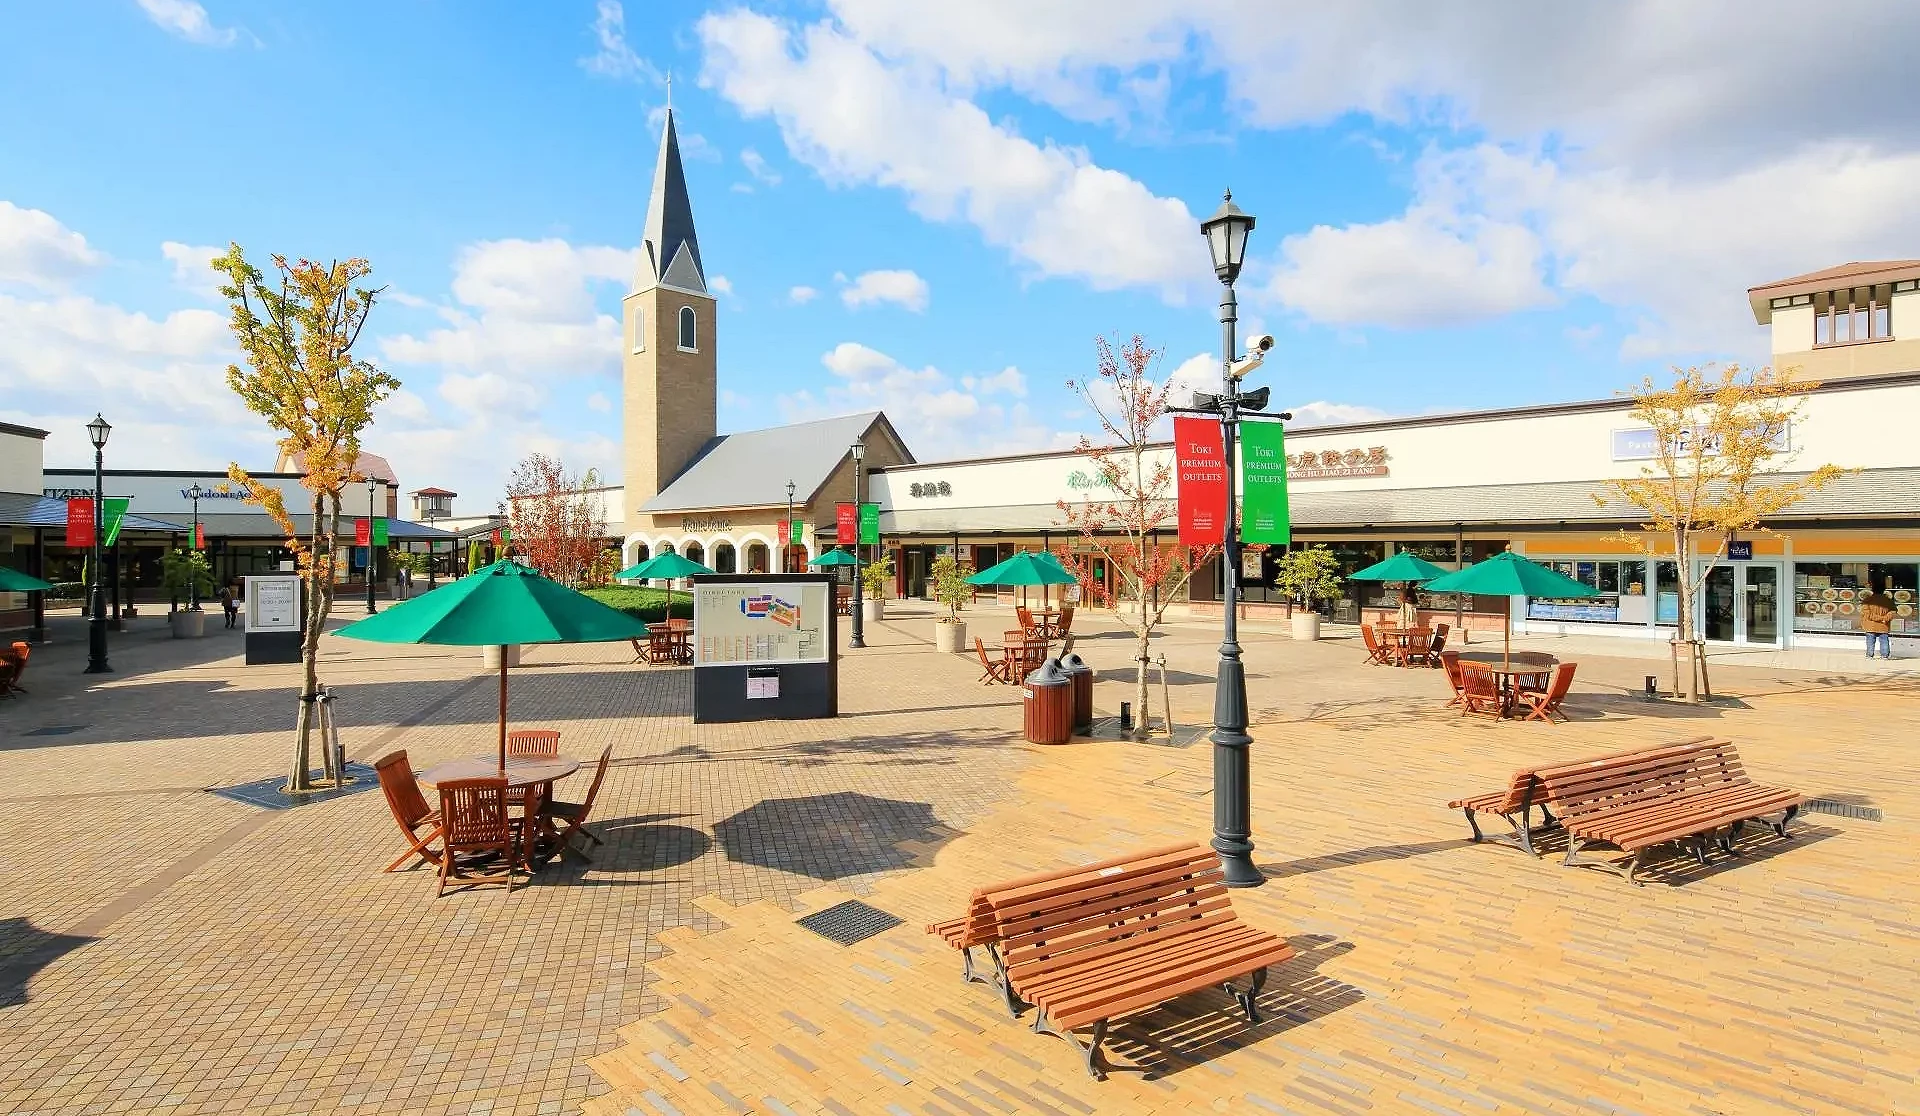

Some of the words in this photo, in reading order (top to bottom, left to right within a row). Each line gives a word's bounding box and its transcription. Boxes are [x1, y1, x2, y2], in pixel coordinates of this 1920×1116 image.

[1189, 443, 1212, 454] TOKI
[1252, 446, 1274, 457] TOKI
[1246, 462, 1282, 470] PREMIUM
[1183, 473, 1222, 481] OUTLETS
[1287, 470, 1306, 479] ONG
[1248, 475, 1282, 483] OUTLETS
